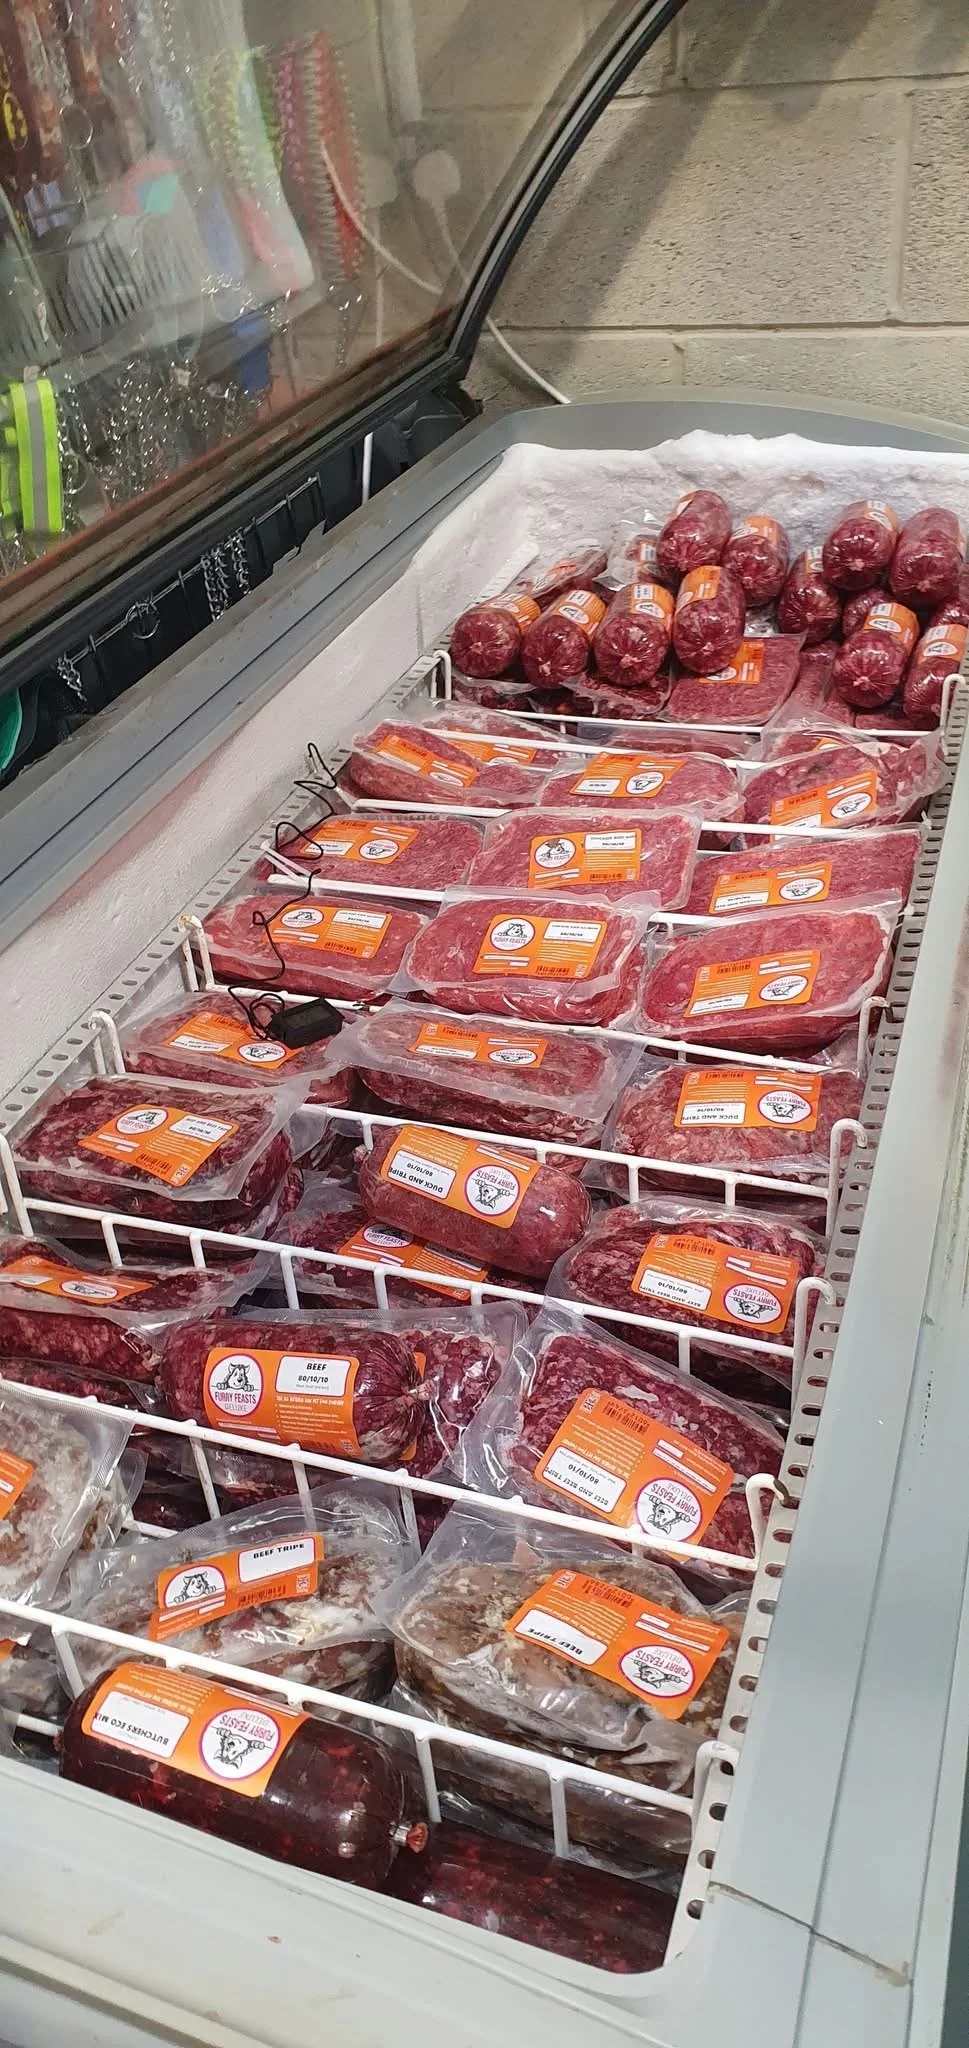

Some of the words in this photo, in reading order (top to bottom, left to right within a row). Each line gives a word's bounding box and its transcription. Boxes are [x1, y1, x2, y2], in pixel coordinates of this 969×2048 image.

[408, 1175, 424, 1186] AND
[476, 1169, 498, 1184] FEASTS
[497, 1178, 516, 1191] FURRY
[424, 1181, 444, 1194] DUCK
[732, 1289, 757, 1302] FEASTS
[757, 1296, 777, 1307] FURRY
[307, 1363, 327, 1371] BEEF
[214, 1391, 233, 1403] FURRY
[234, 1392, 257, 1404] FEASTS
[567, 1463, 600, 1485] 80/10/10
[562, 1477, 578, 1489] BEEF
[578, 1486, 594, 1498] AND
[593, 1494, 609, 1506] BEEF
[650, 1482, 678, 1504] FEASTS
[666, 1482, 693, 1503] DELUXE
[675, 1497, 700, 1517] FURRY
[253, 1548, 276, 1559] BEEF
[278, 1543, 305, 1553] TRIPE
[527, 1626, 558, 1644] TRIPE
[558, 1640, 584, 1656] BEEF
[653, 1647, 684, 1665] DELUXE
[634, 1648, 665, 1668] FEASTS
[664, 1661, 690, 1678] FURRY
[110, 1718, 127, 1730] ECO
[219, 1713, 250, 1734] FEASTS
[126, 1723, 169, 1746] BUTCHERS
[249, 1724, 275, 1742] FURRY
